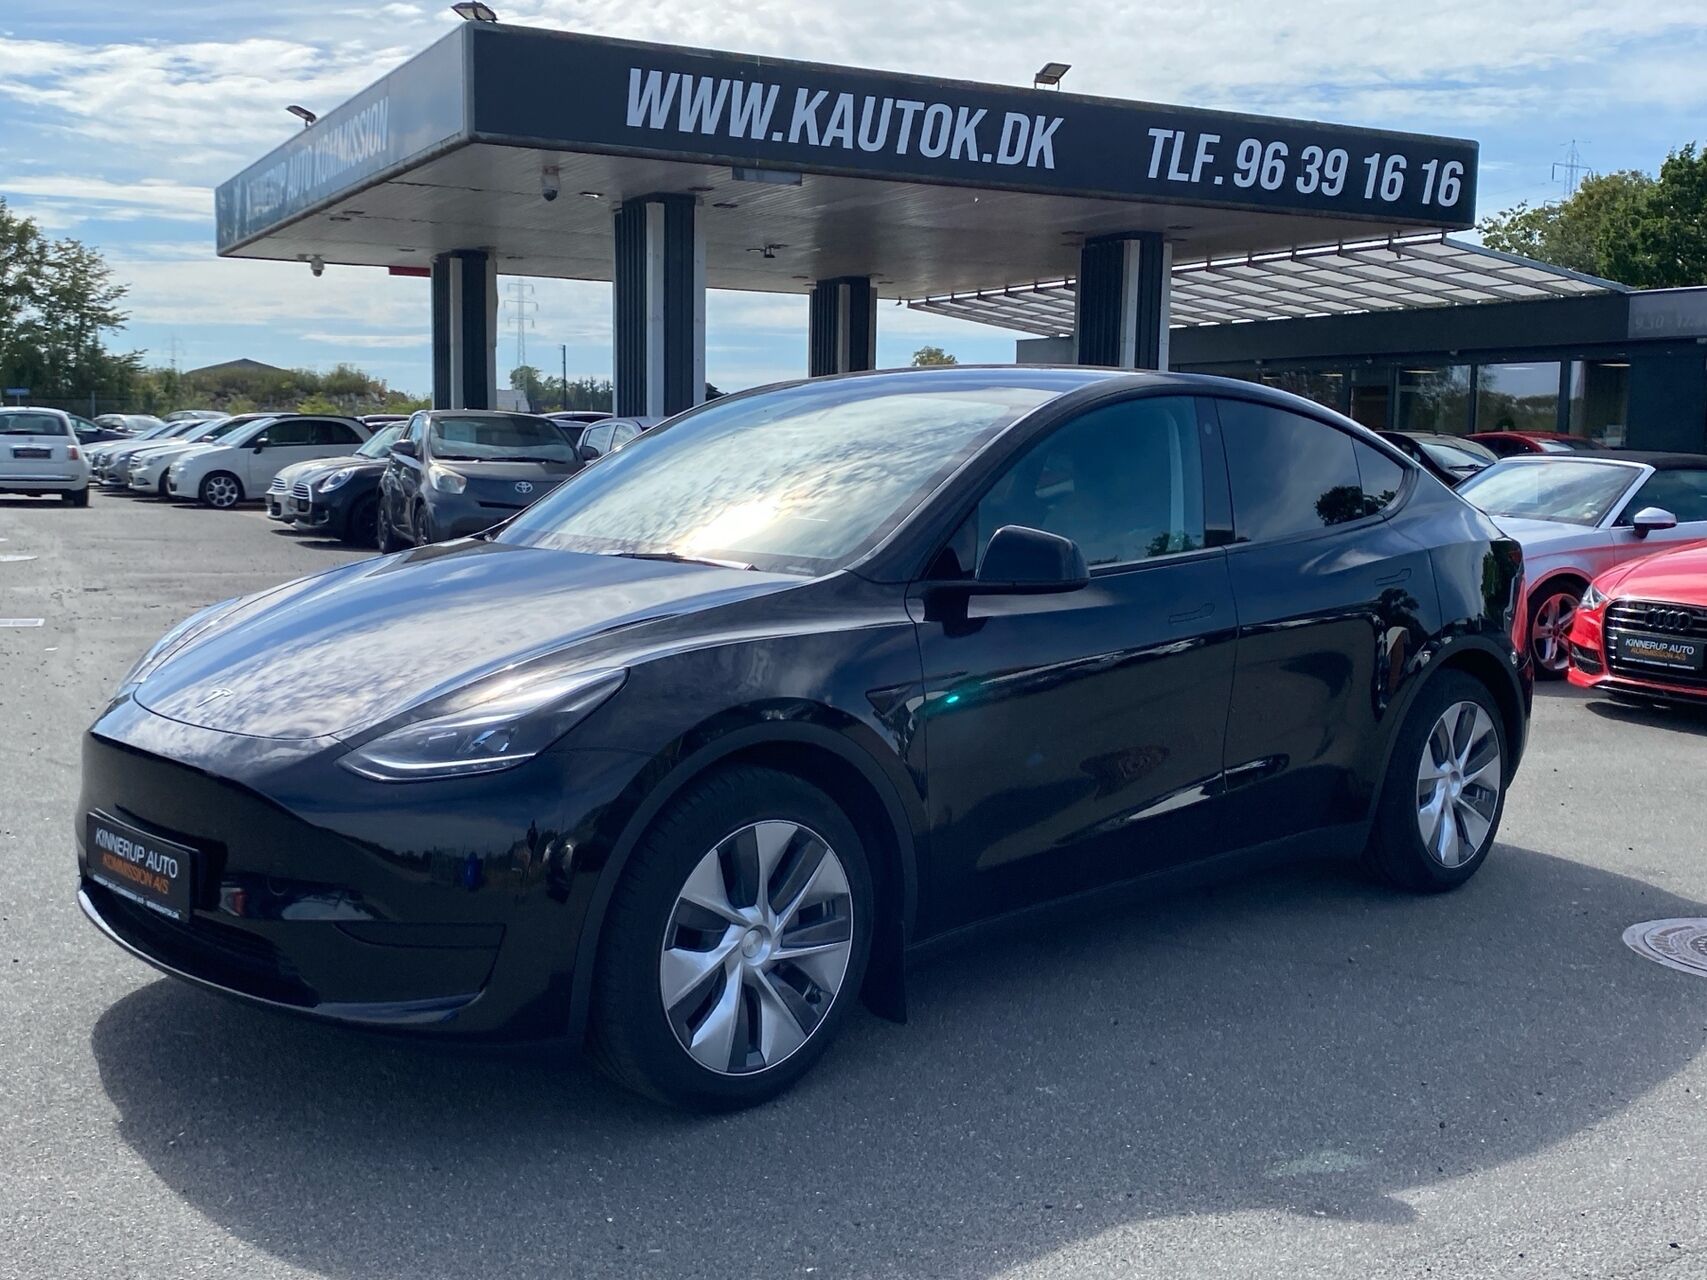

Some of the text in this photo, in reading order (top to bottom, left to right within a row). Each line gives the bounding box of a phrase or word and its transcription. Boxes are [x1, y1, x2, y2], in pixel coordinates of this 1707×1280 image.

[626, 67, 1065, 170] WWW.KAUTOK.DK
[1147, 127, 1464, 208] TLF. 96 39 16 16
[1625, 638, 1695, 655] KINNERUP AUTO
[95, 827, 178, 879] KINNERUP AUTO
